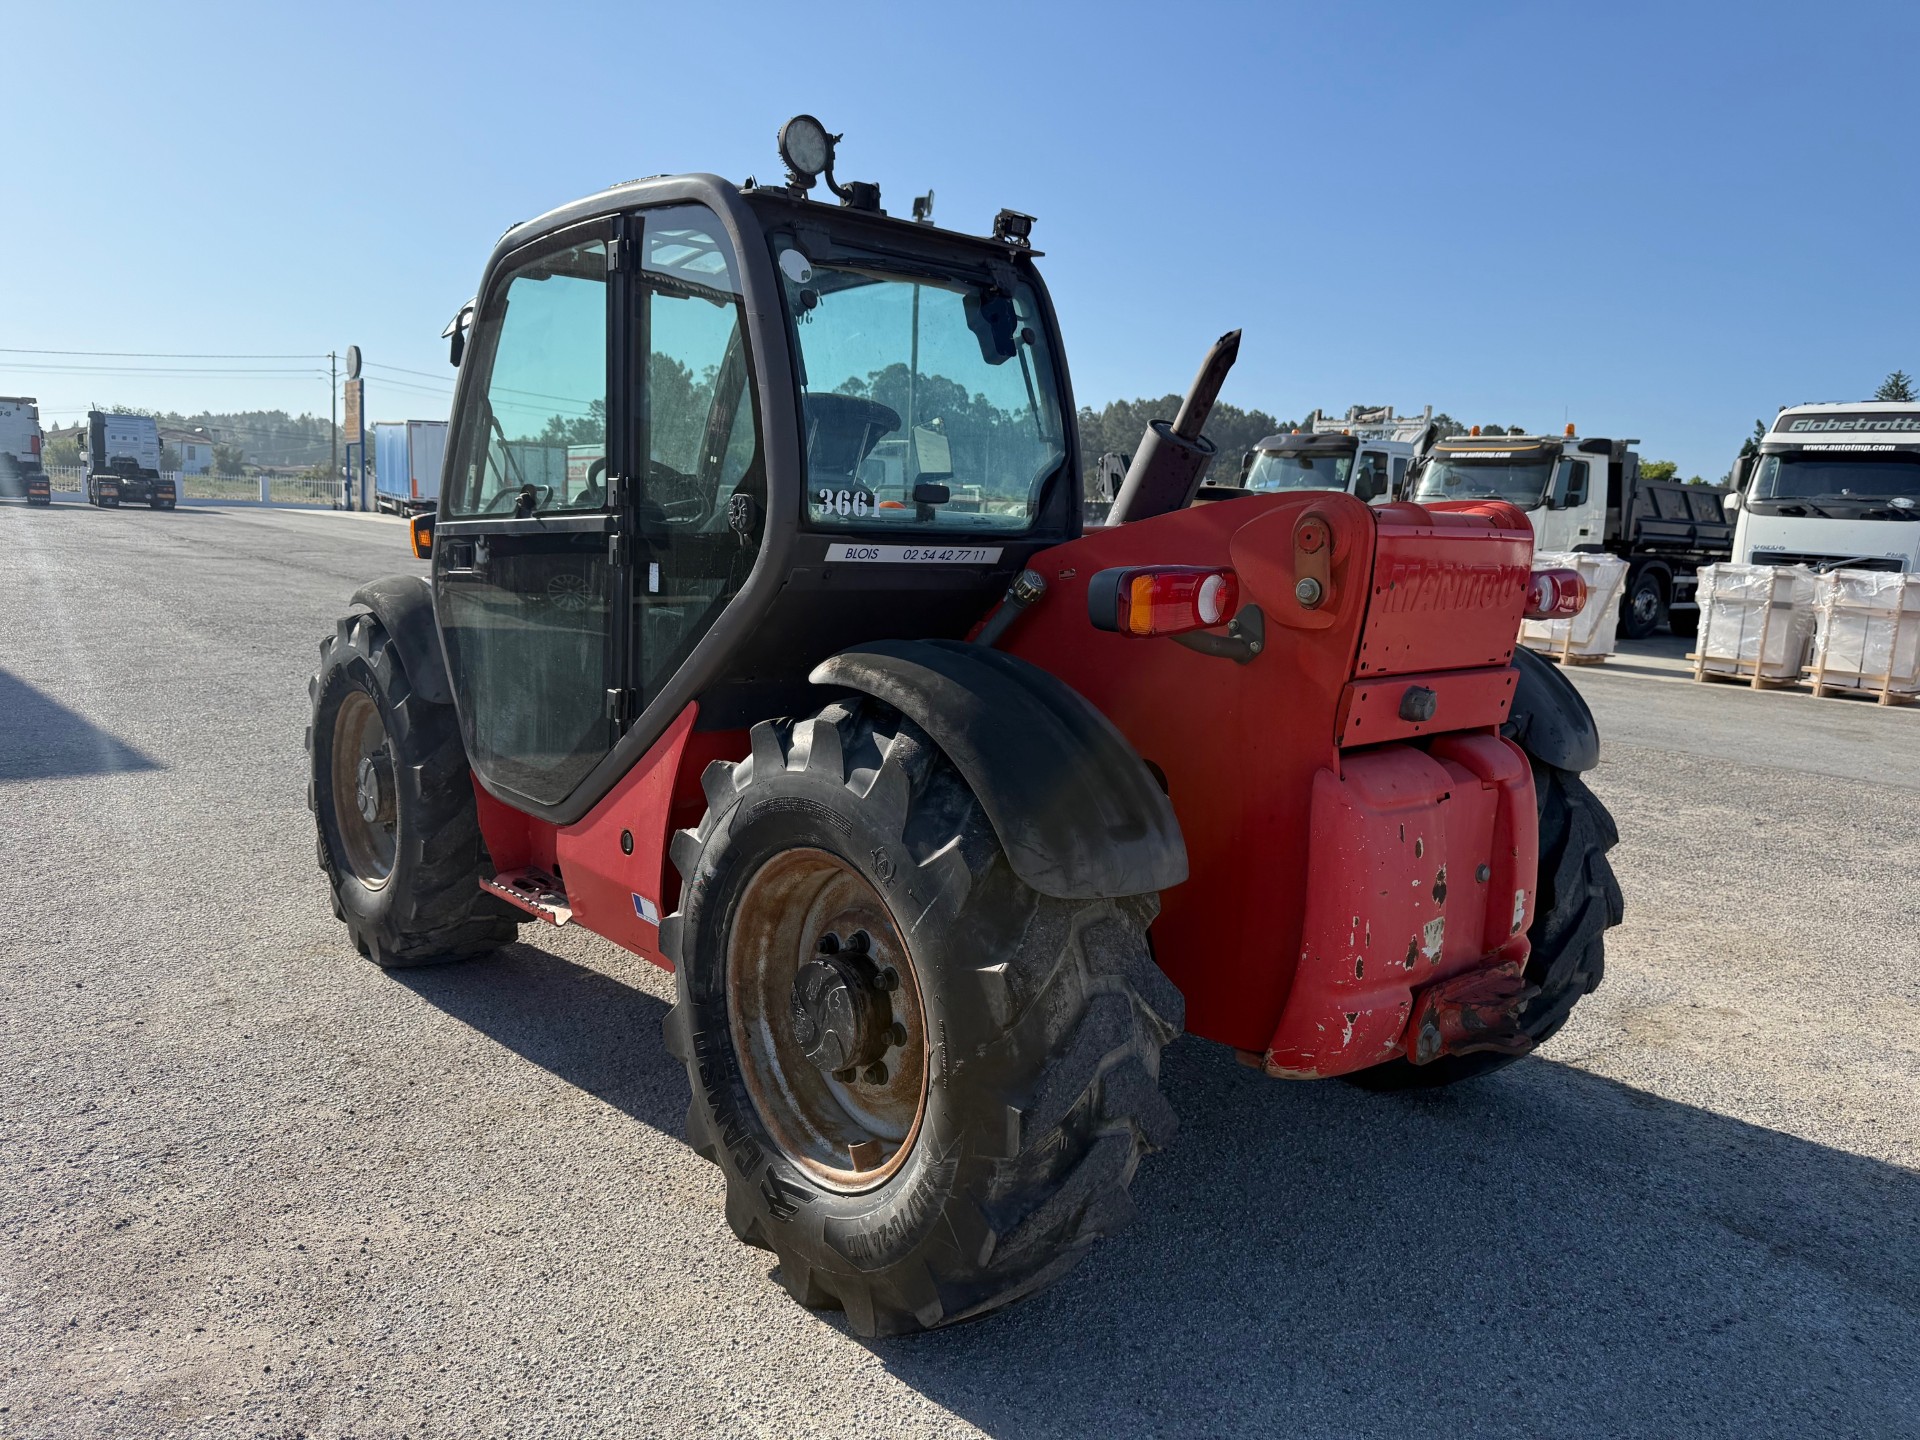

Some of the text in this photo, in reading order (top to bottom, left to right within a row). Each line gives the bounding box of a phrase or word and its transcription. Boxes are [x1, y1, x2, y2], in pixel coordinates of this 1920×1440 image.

[1802, 443, 1896, 452] www.autotmp.com
[818, 488, 881, 518] 3661
[845, 548, 986, 561] BLOIS 02 54 42 77 11
[1382, 564, 1526, 614] MANITOU
